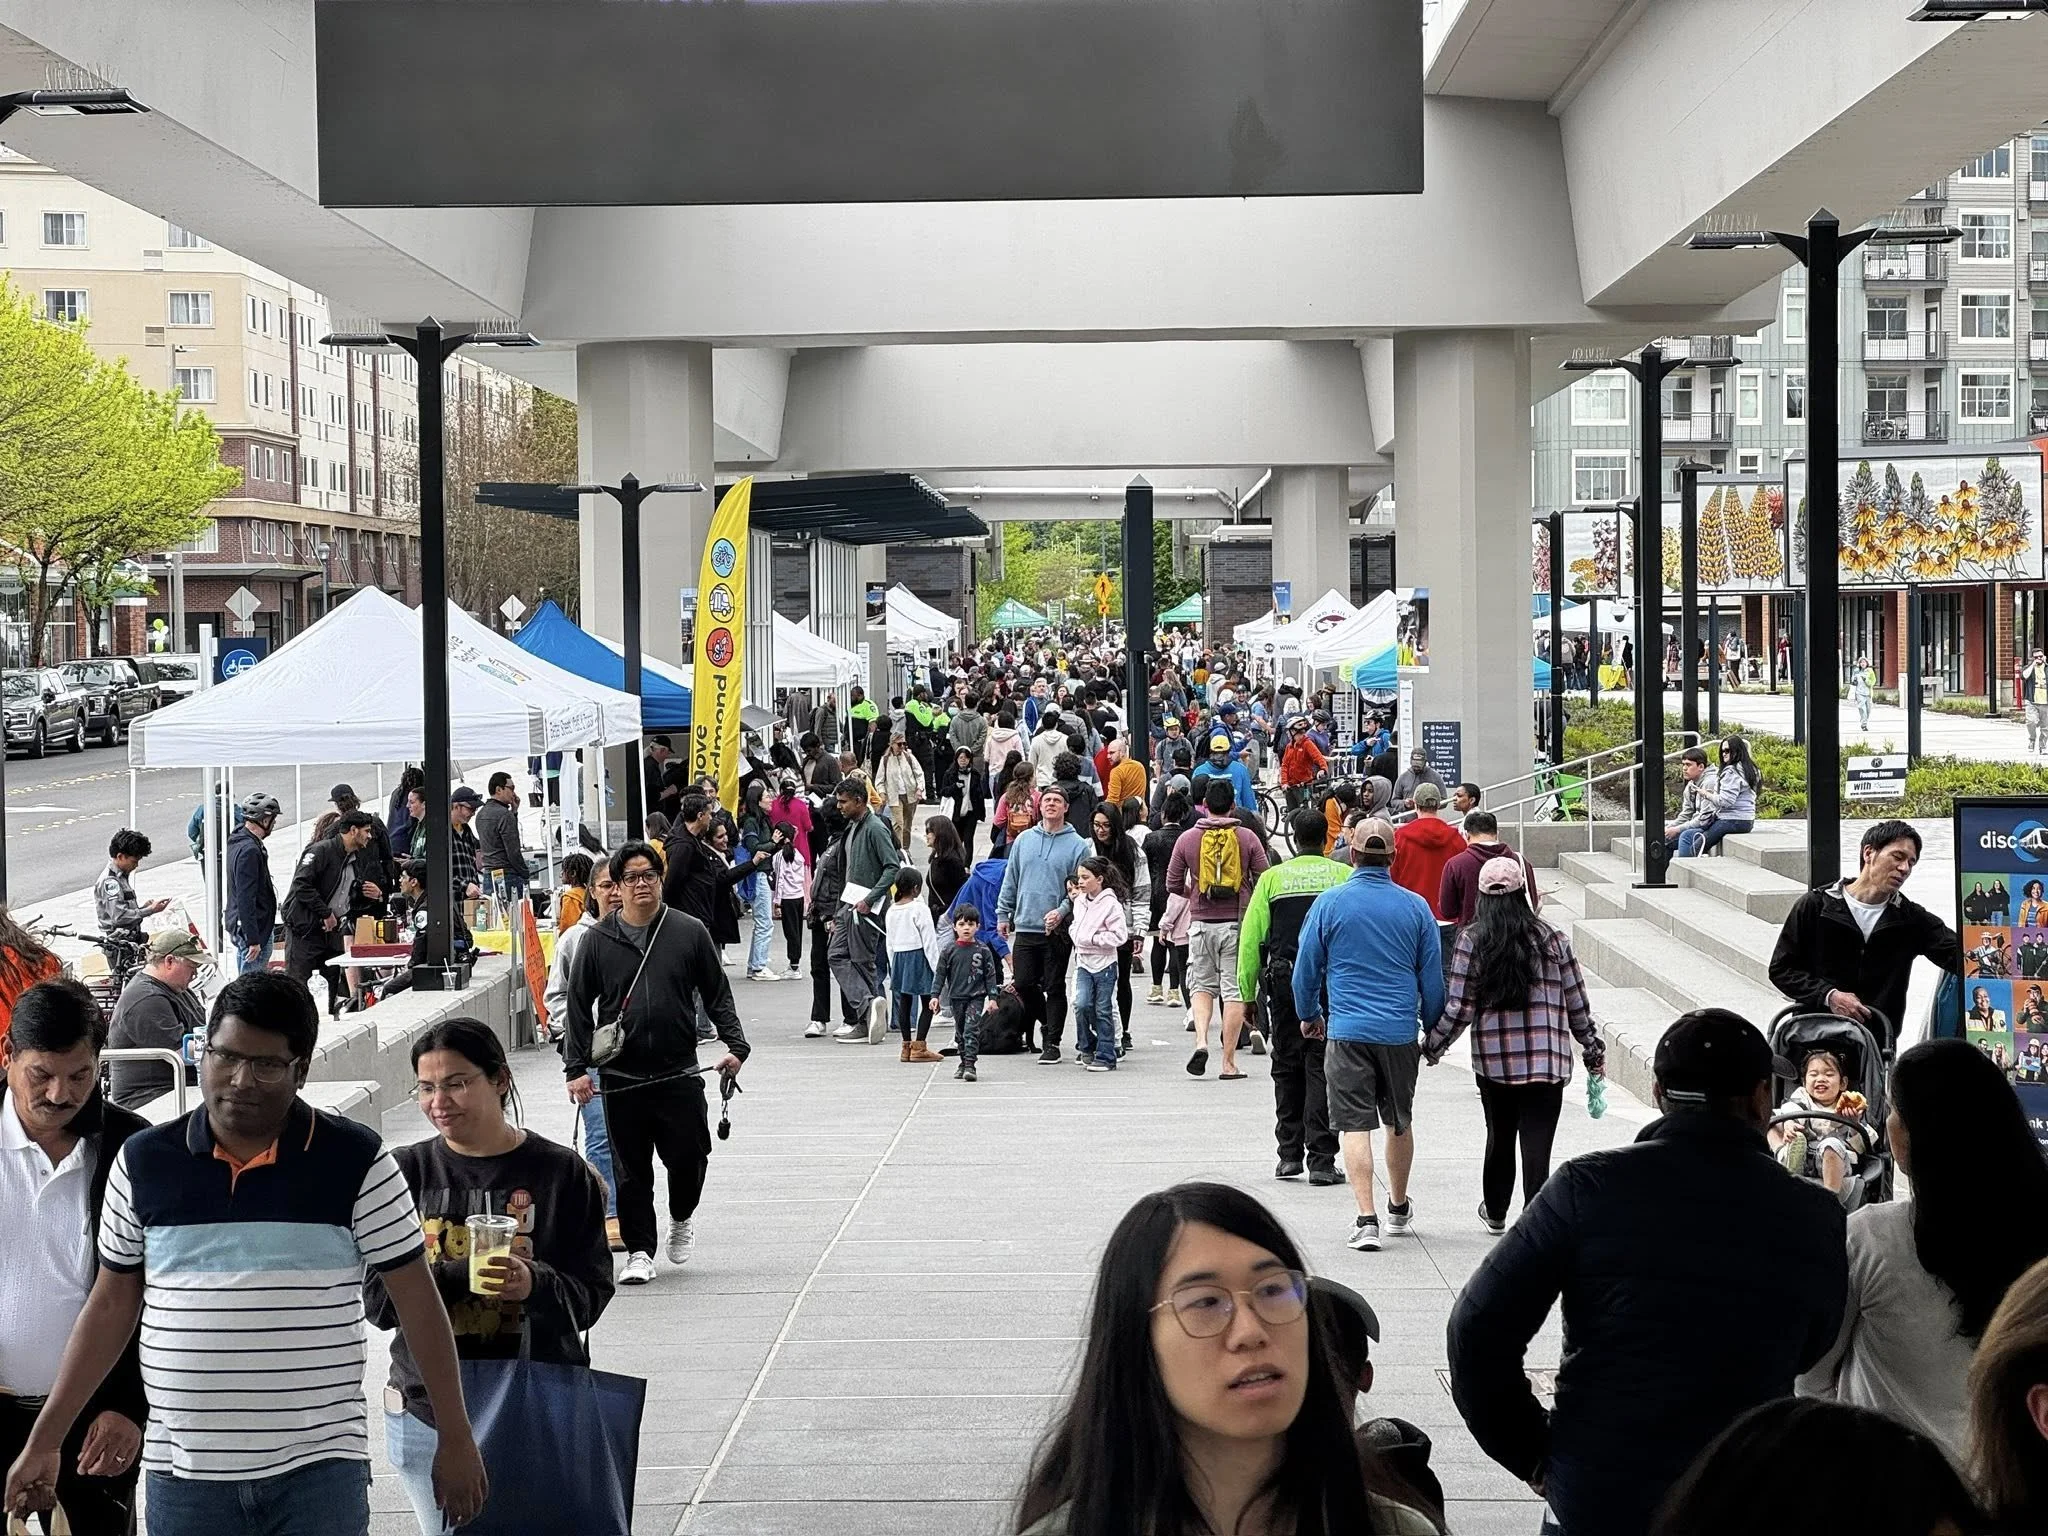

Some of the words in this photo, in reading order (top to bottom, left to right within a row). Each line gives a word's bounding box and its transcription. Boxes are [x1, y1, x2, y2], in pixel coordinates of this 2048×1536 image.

[710, 674, 727, 780] edmond
[1854, 782, 1871, 790] with
[1282, 876, 1337, 891] SAFETY
